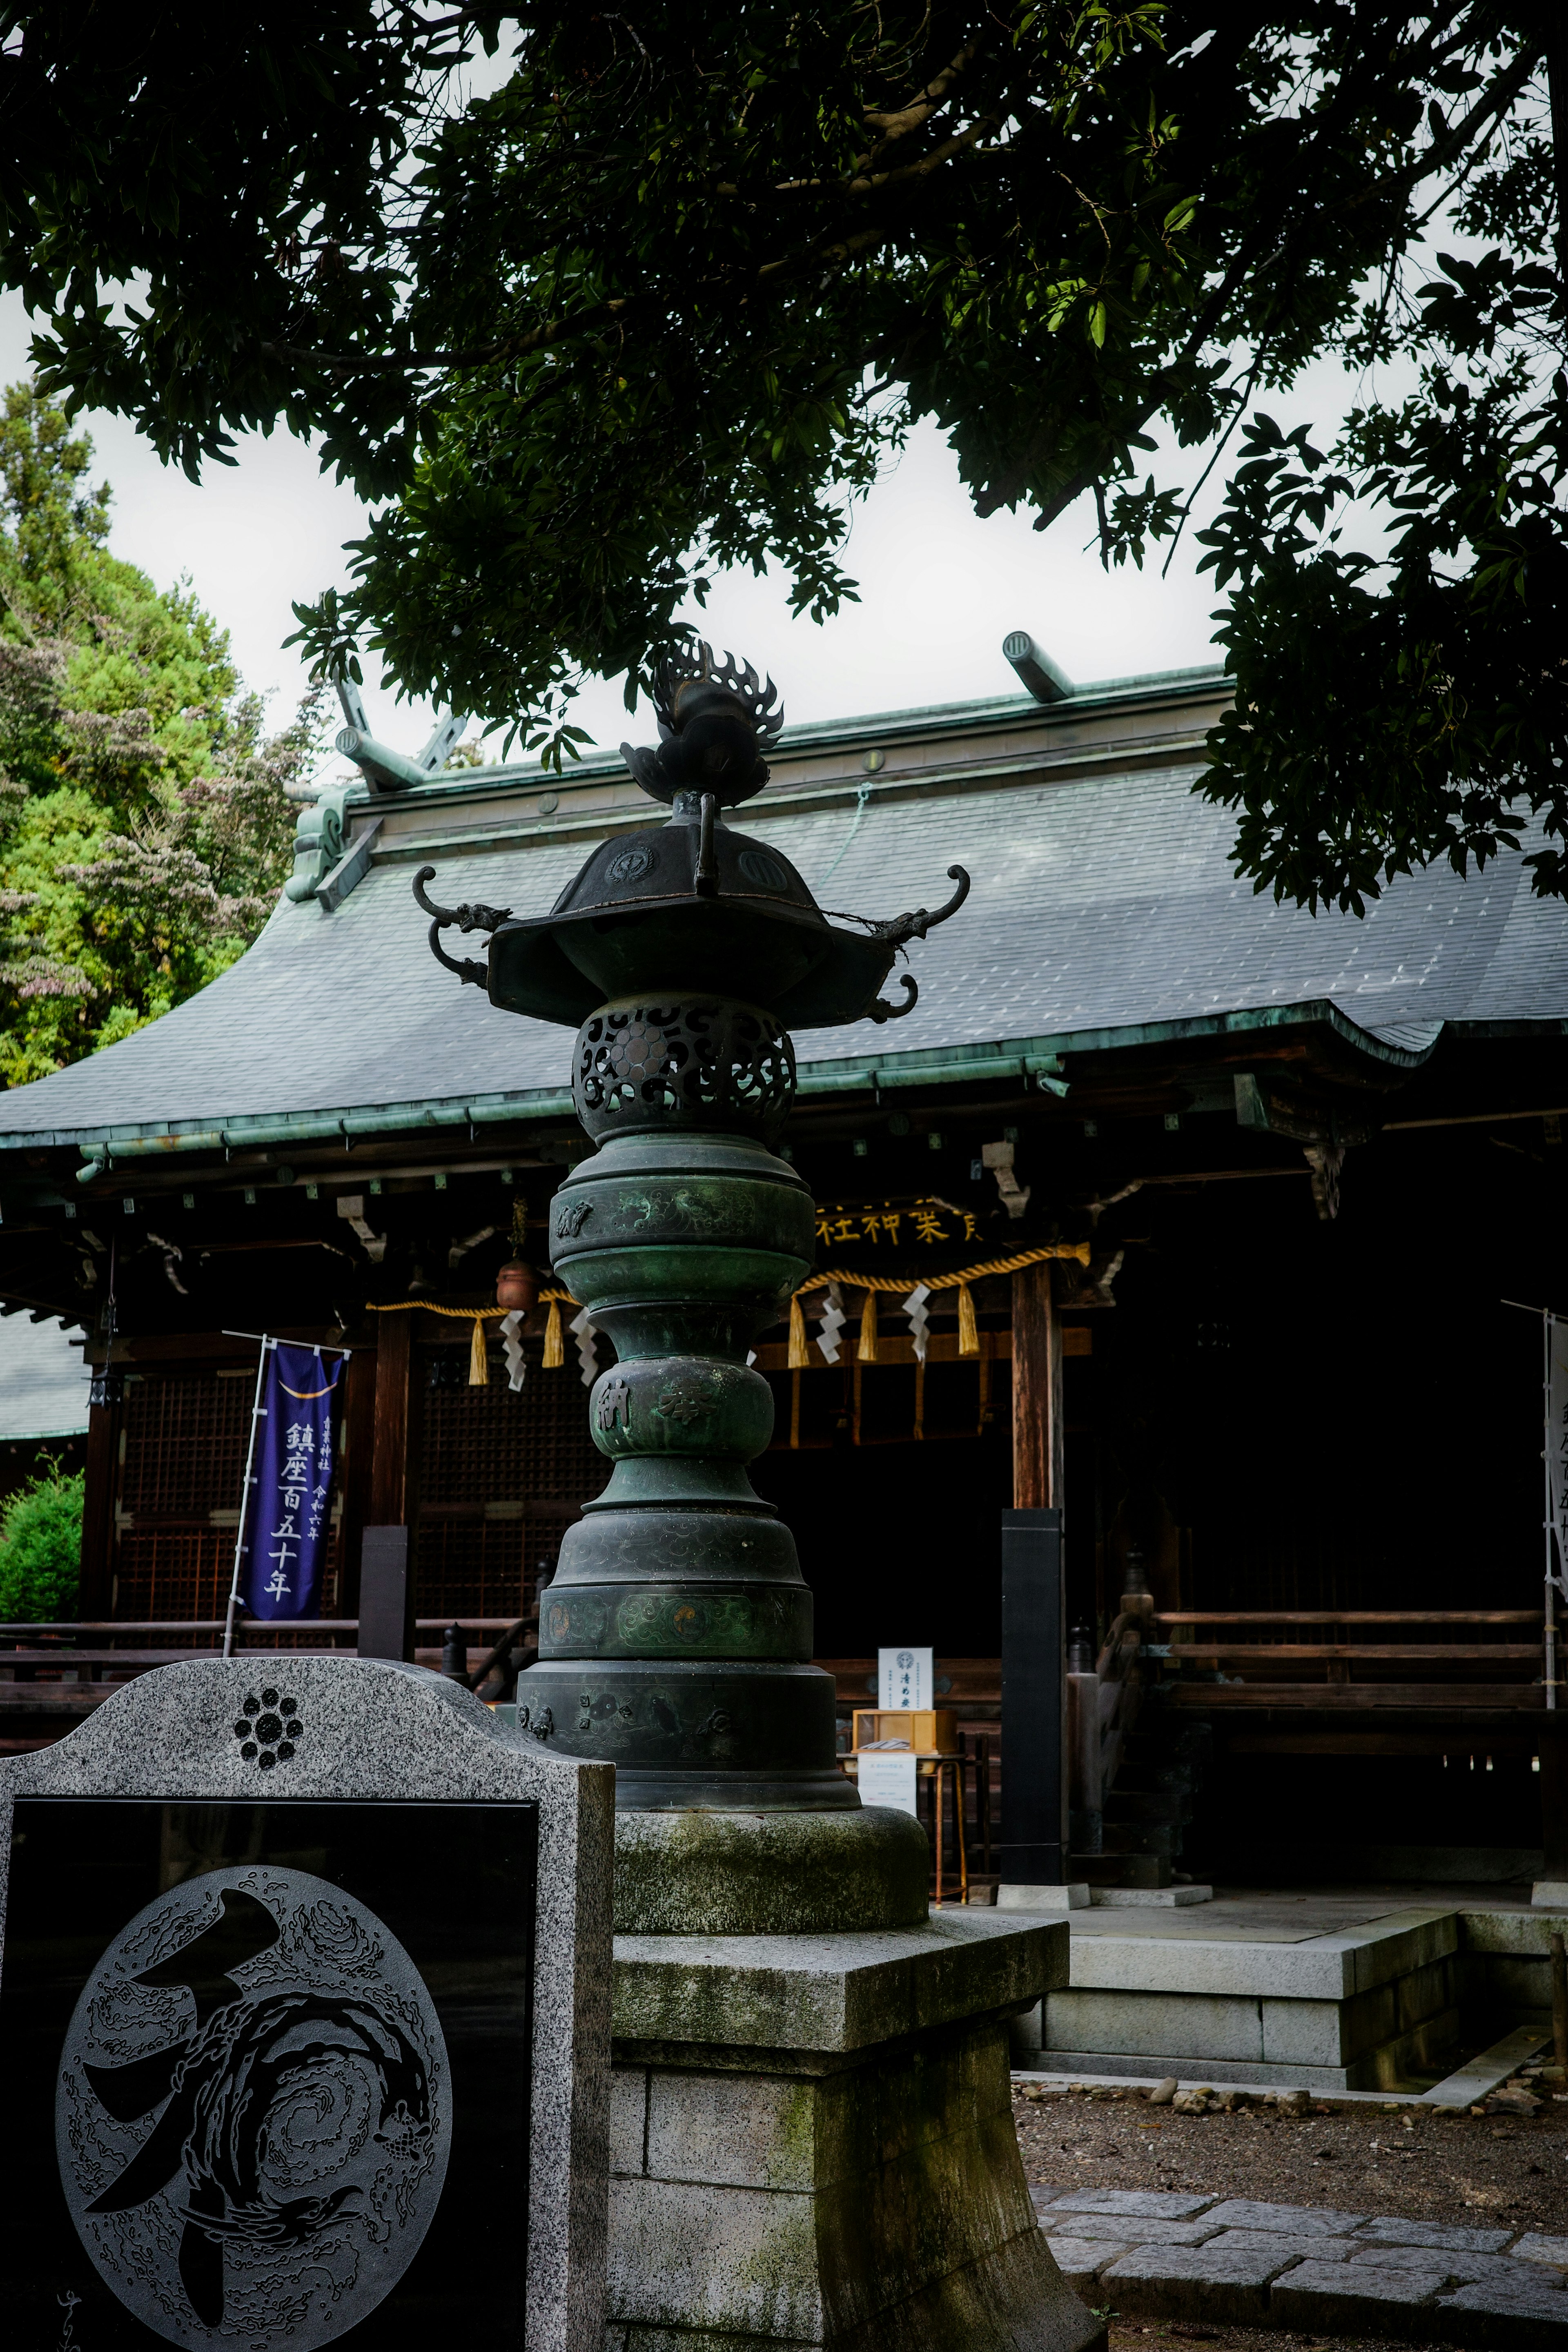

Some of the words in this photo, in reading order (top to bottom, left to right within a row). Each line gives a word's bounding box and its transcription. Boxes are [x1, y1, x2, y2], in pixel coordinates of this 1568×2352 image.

[317, 1415, 332, 1471] 青葉神社
[264, 1422, 316, 1603] 鎮座百五十年
[307, 1485, 327, 1540] 令和六年
